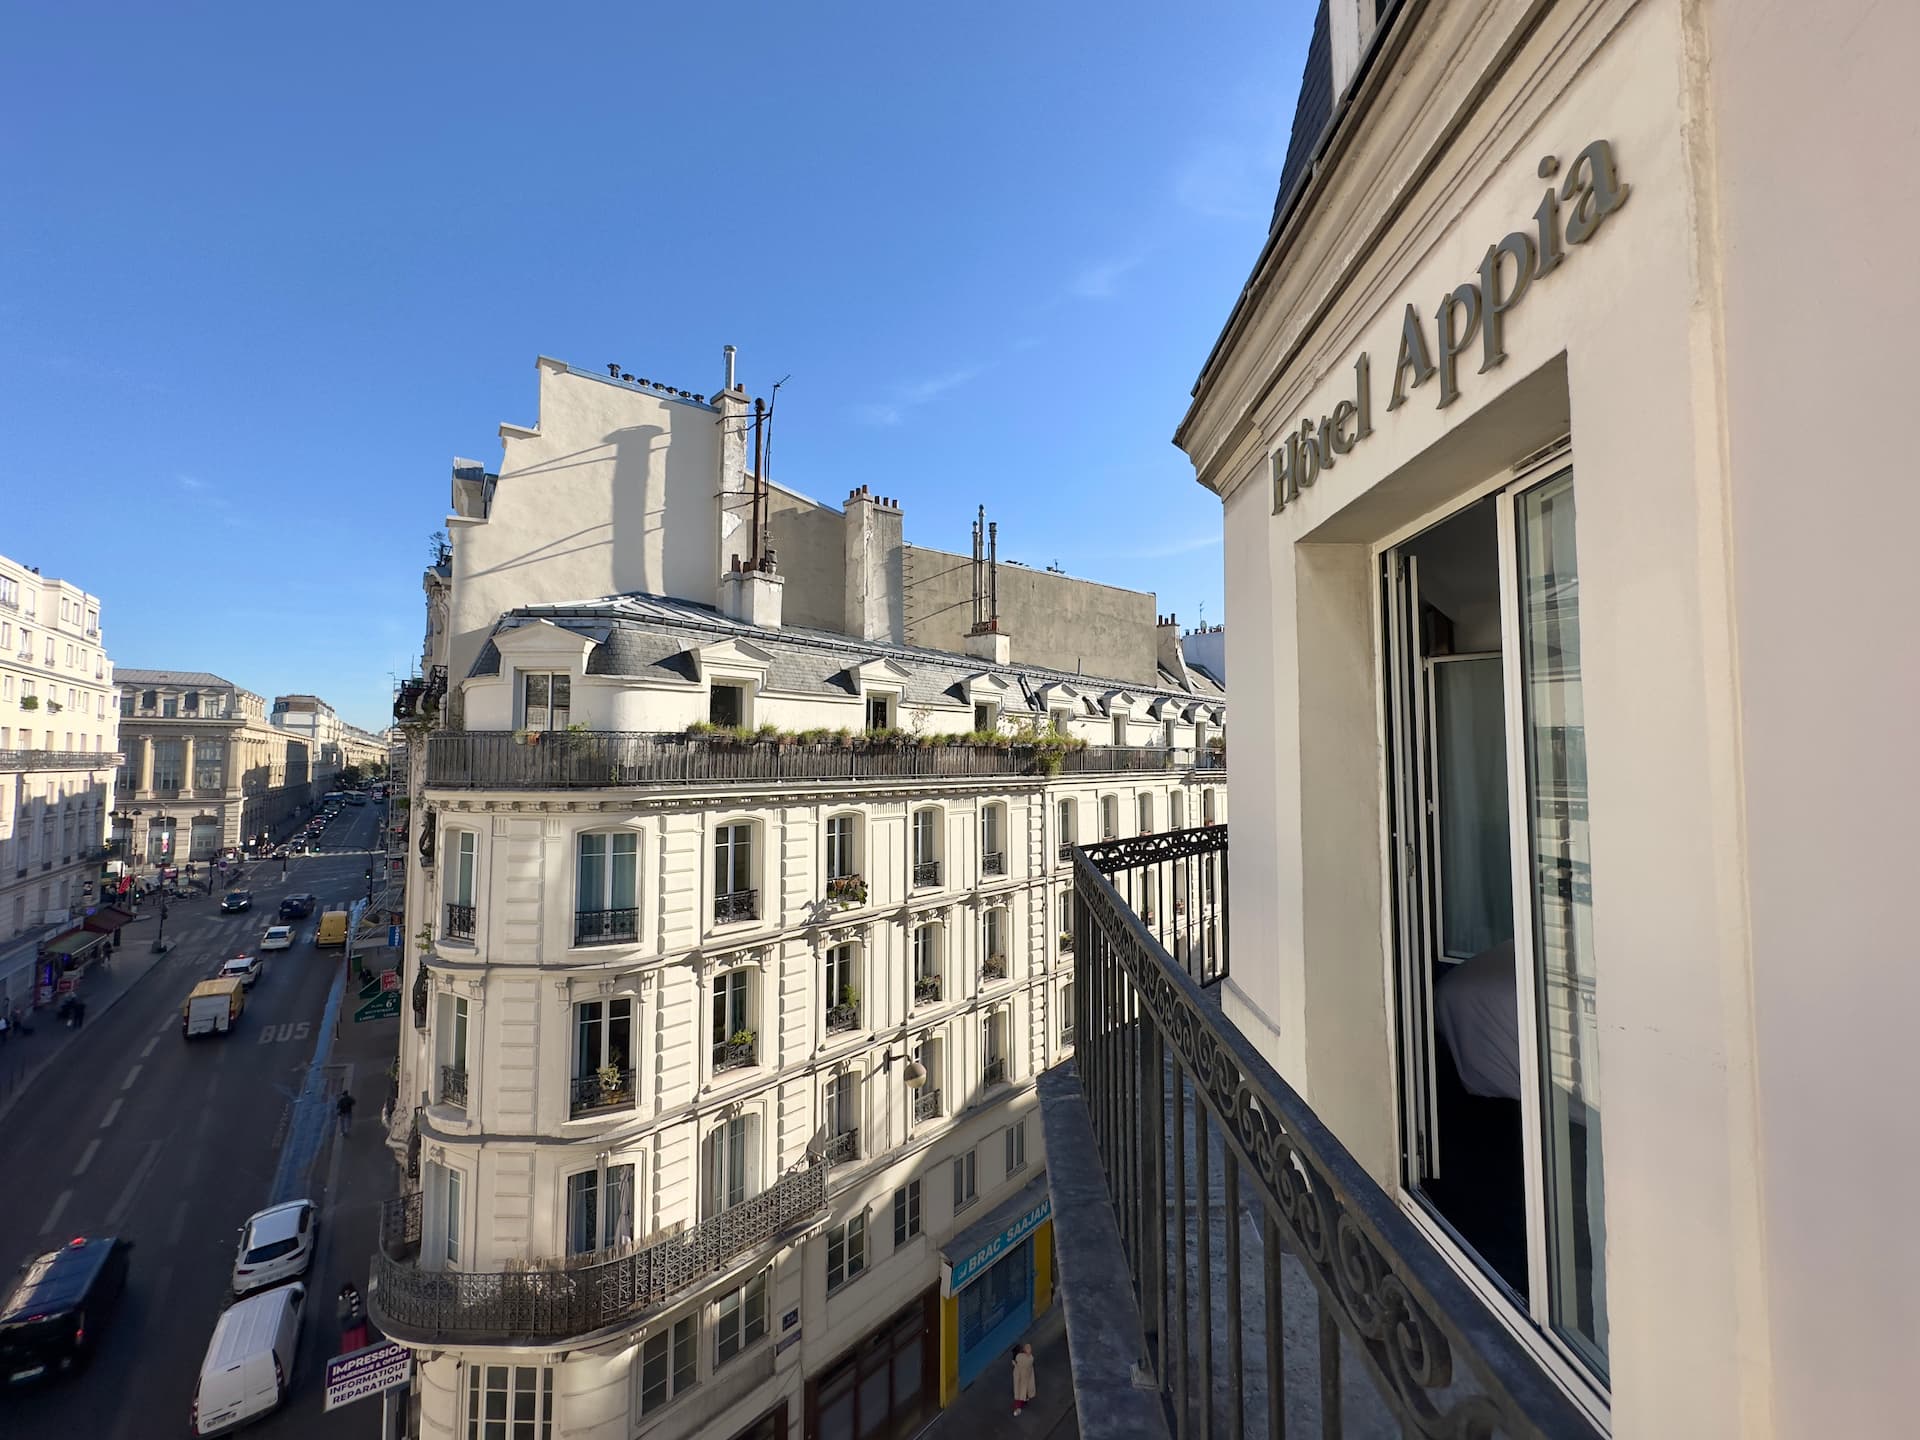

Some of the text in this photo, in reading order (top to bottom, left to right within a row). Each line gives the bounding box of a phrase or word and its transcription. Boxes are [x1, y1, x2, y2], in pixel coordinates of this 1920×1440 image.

[1271, 139, 1629, 516] Hôtel Appia
[257, 1022, 310, 1045] BUS
[968, 1200, 1049, 1272] BRAC SAAJAN
[382, 1352, 408, 1365] OFFSET
[329, 1361, 408, 1395] INFORMATIQUE
[333, 1373, 403, 1404] REPARATION
